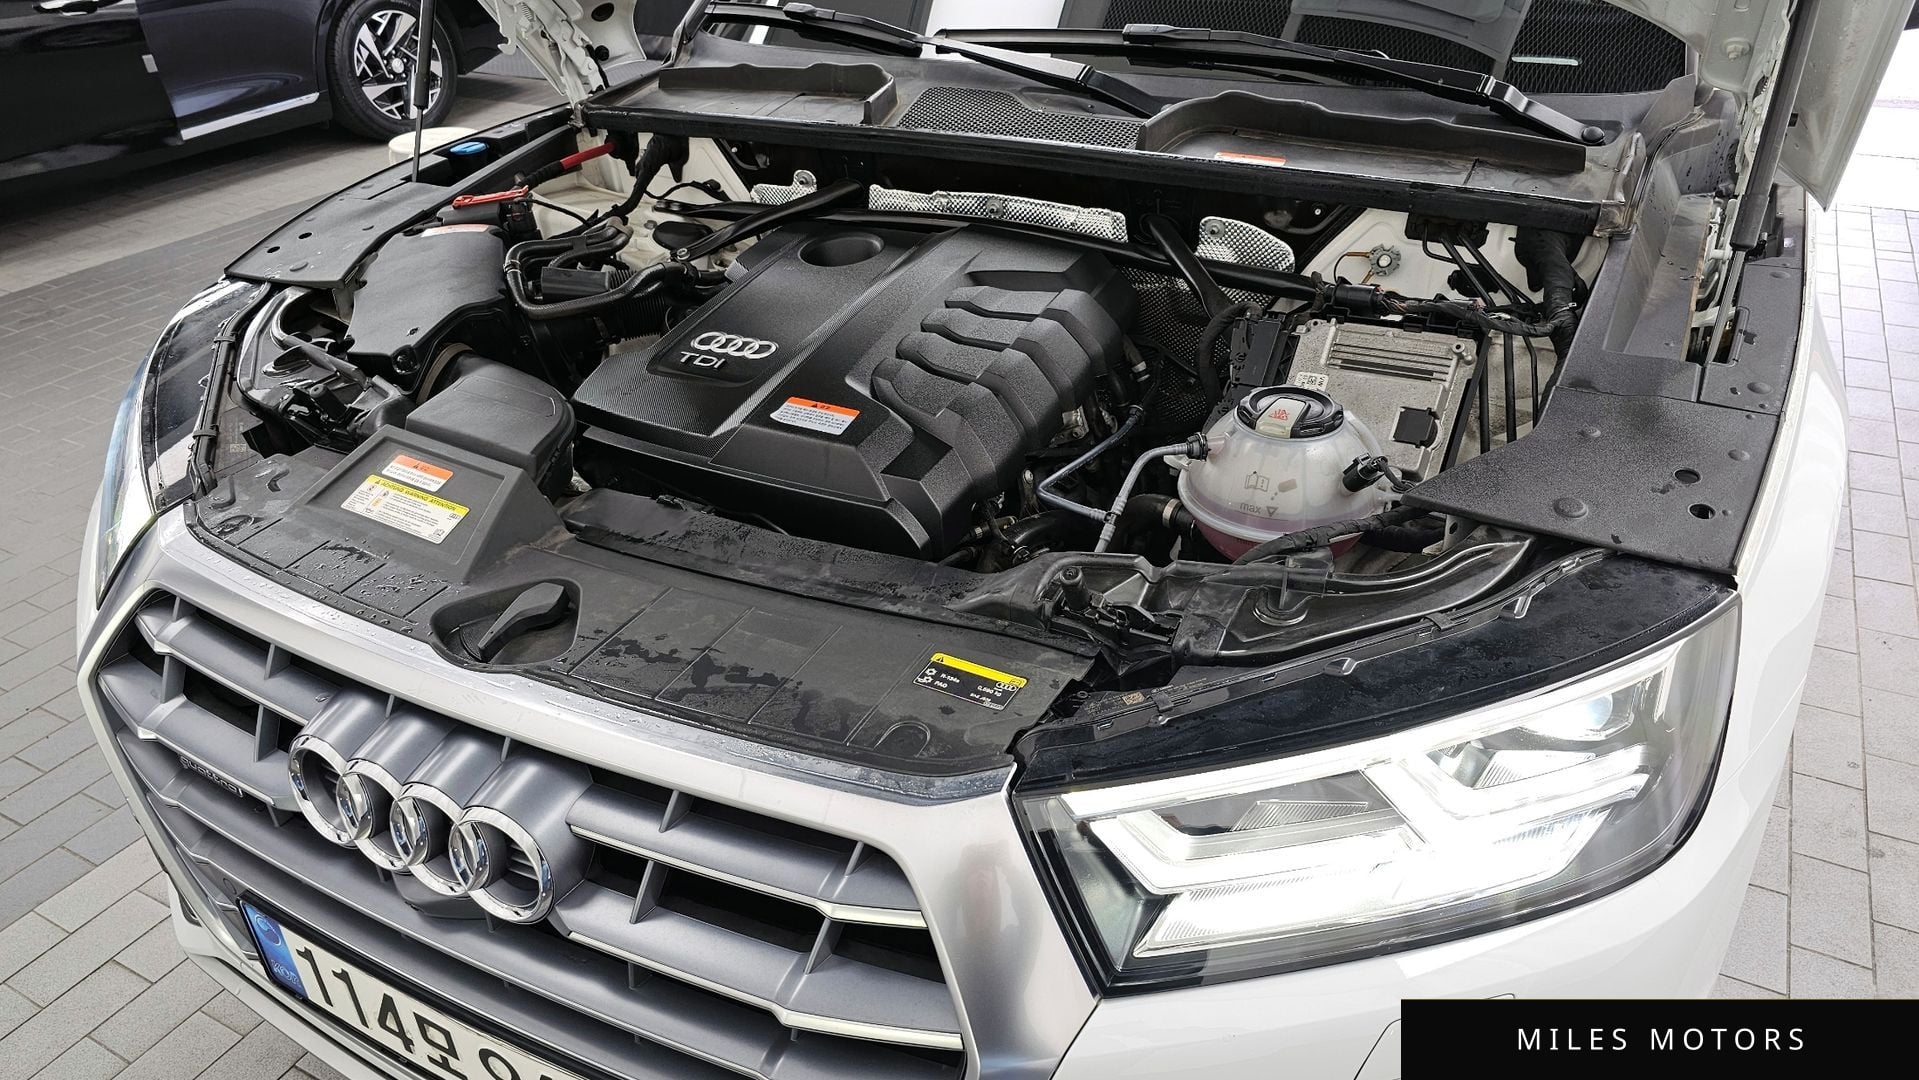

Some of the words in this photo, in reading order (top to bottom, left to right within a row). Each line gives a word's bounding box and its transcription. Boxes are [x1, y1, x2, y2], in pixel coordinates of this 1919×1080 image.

[680, 351, 726, 369] TDI
[1239, 502, 1262, 515] max
[180, 755, 238, 793] quattro
[271, 960, 299, 985] KOR
